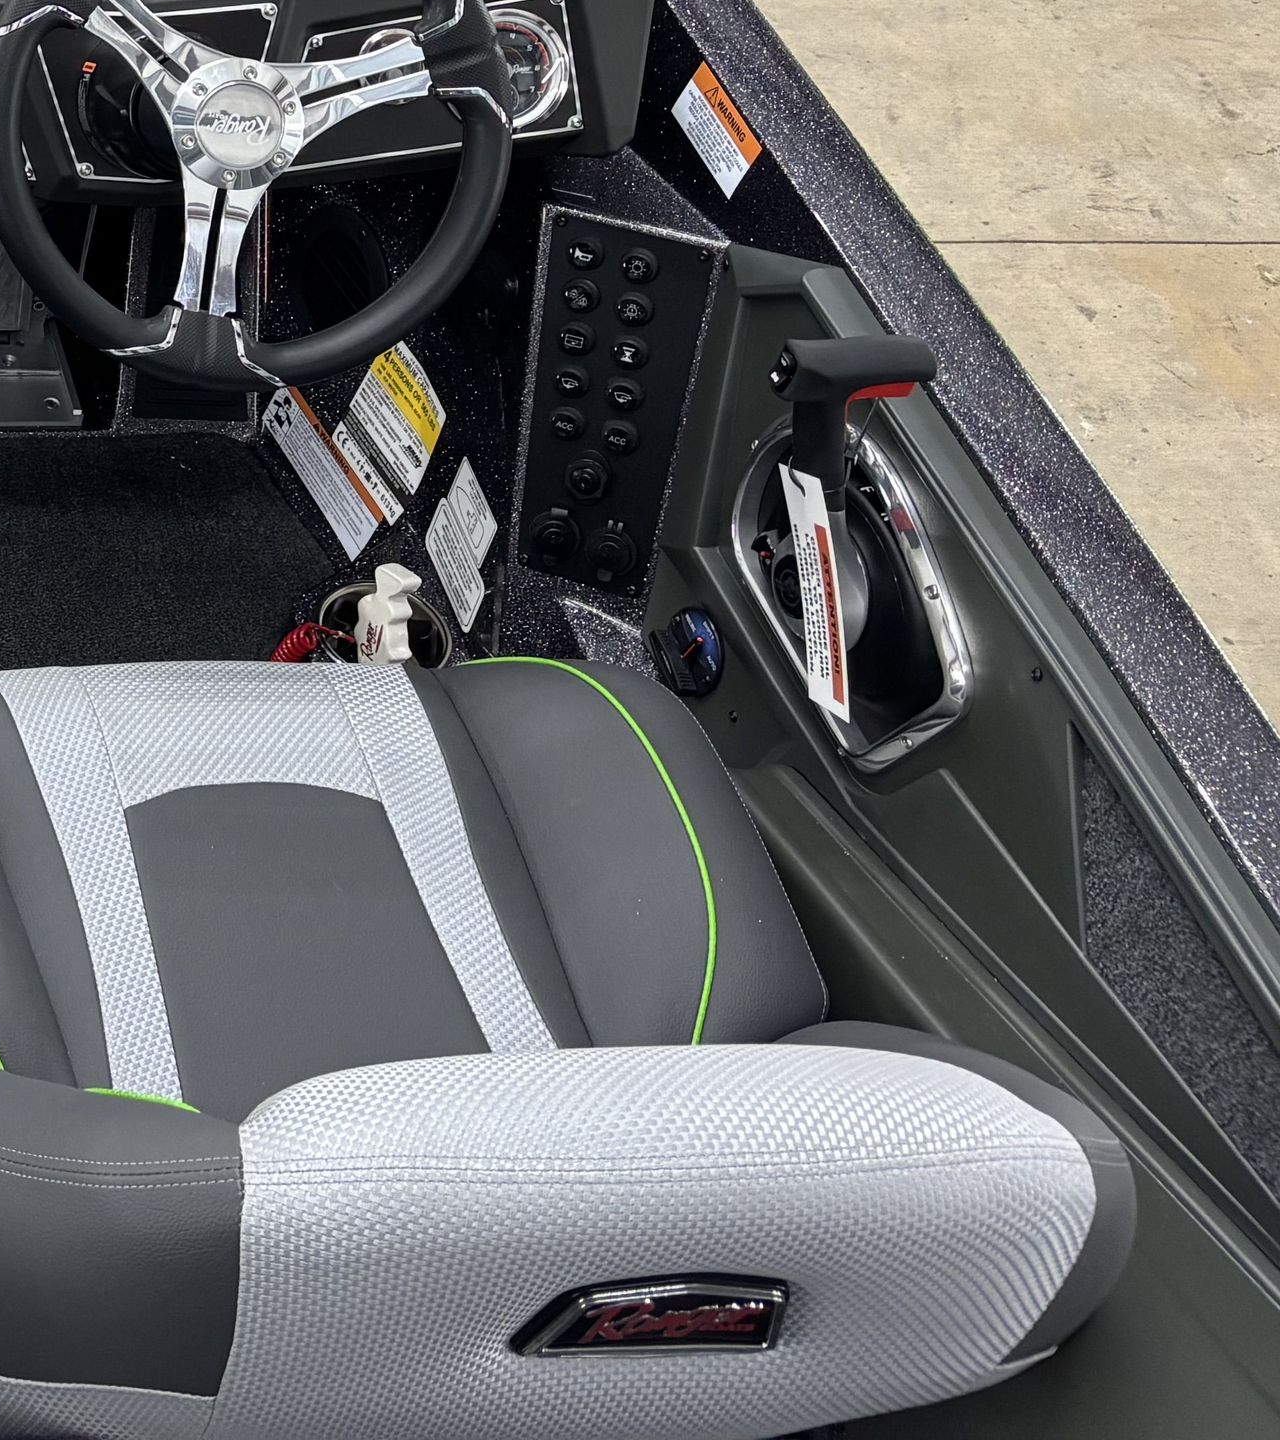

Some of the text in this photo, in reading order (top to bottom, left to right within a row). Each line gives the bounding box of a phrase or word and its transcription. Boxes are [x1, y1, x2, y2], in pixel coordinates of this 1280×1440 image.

[209, 113, 271, 145] Ranger
[716, 98, 746, 143] WARNING
[388, 357, 414, 392] PERSONS
[411, 388, 422, 403] OR
[556, 421, 573, 430] ACC
[609, 436, 626, 445] ACC
[318, 429, 350, 475] WARNING
[812, 584, 818, 605] TO
